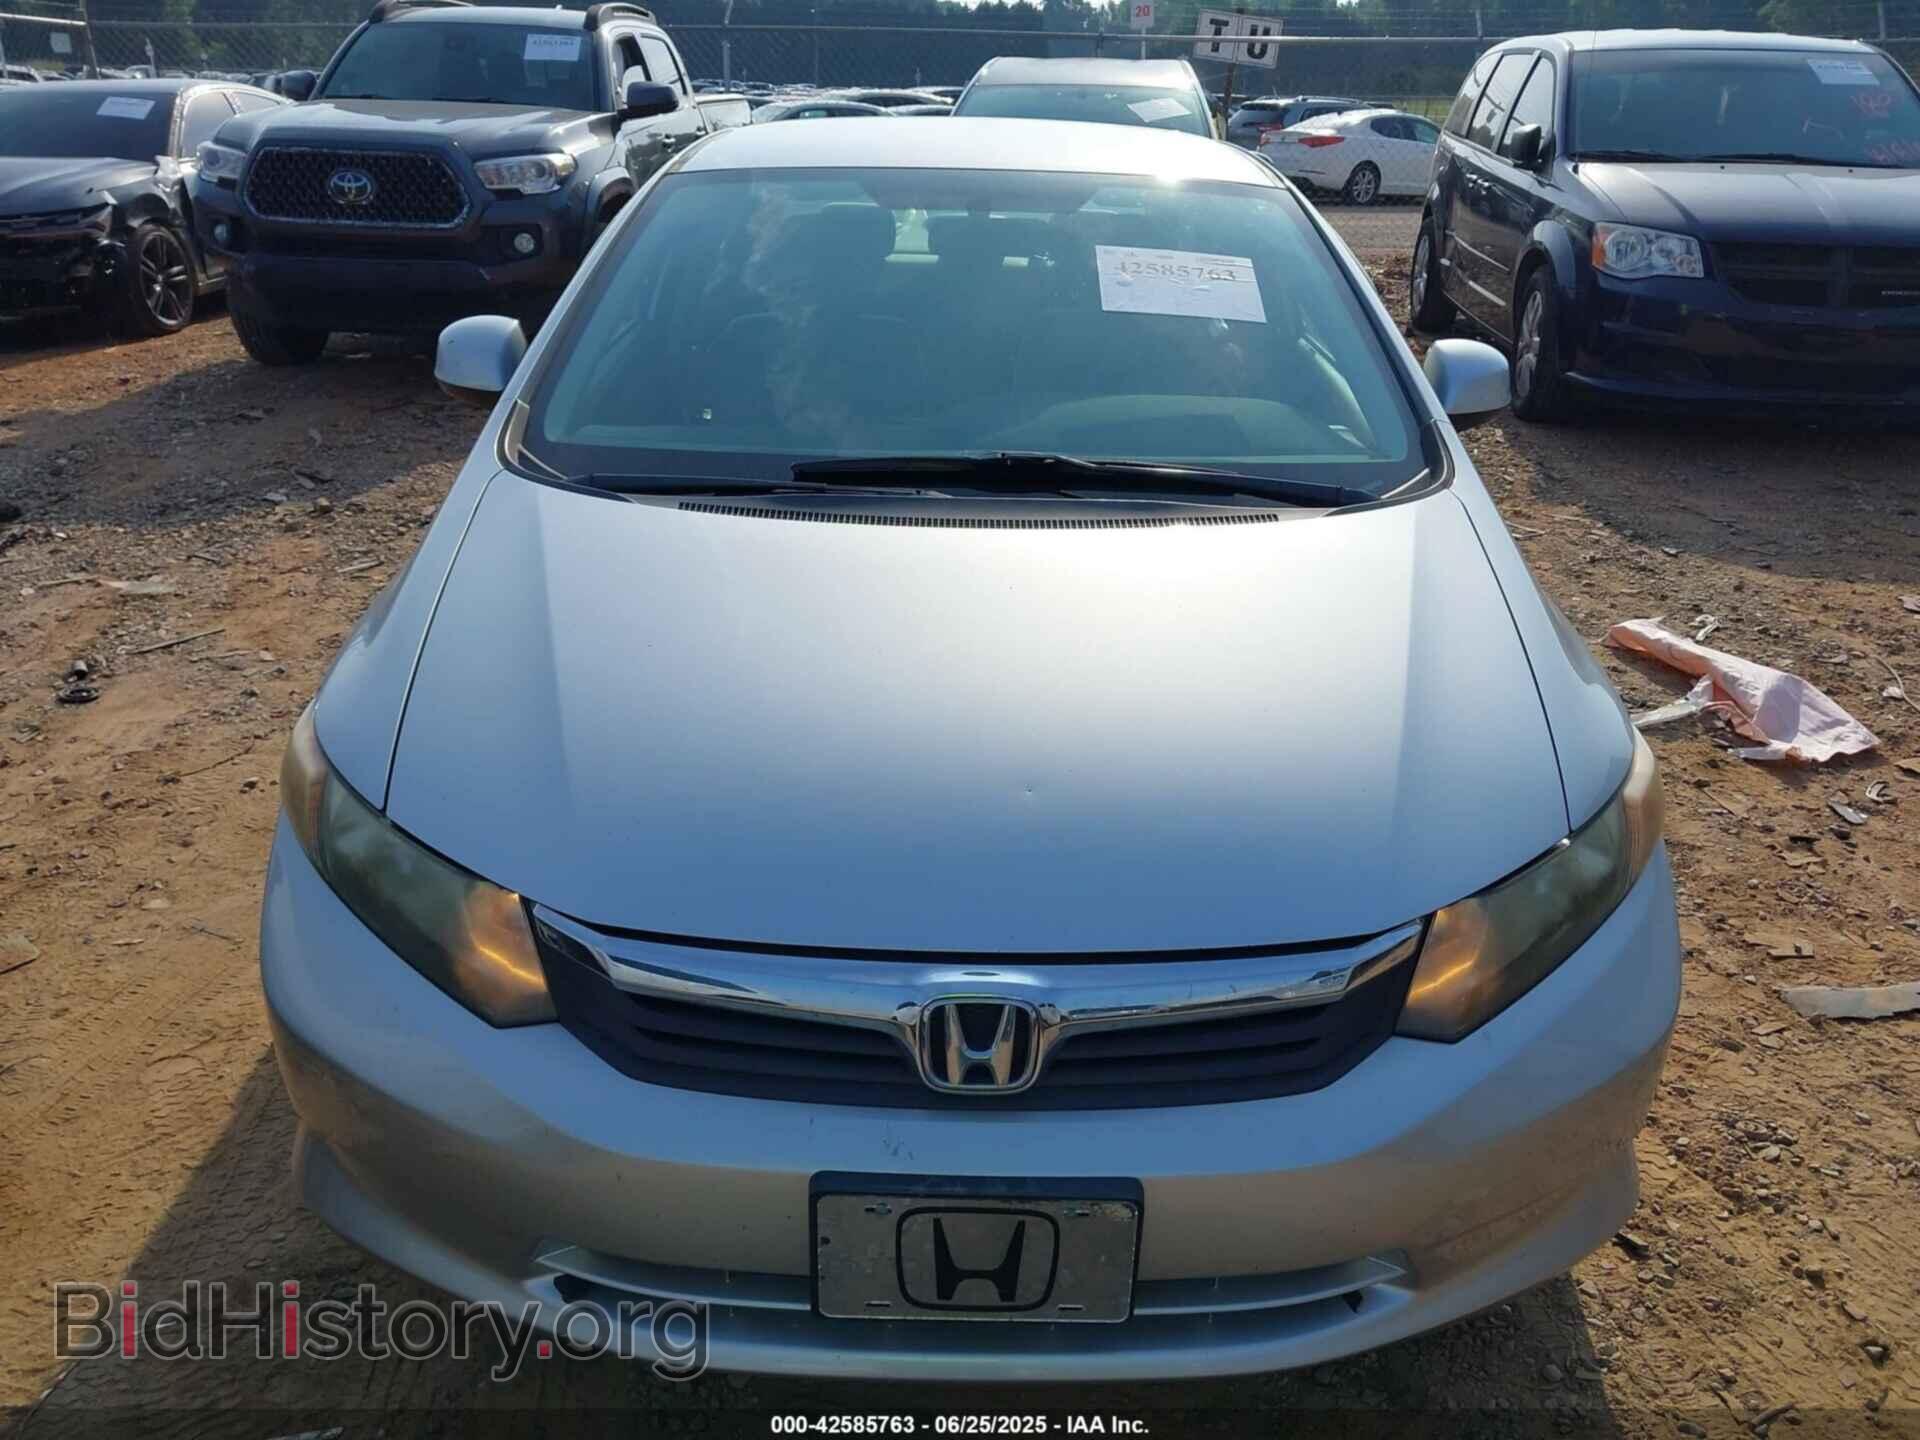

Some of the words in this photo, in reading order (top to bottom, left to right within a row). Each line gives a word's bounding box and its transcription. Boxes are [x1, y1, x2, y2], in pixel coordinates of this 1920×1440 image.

[1135, 5, 1150, 17] 20
[1209, 18, 1230, 53] T
[1247, 24, 1271, 59] U
